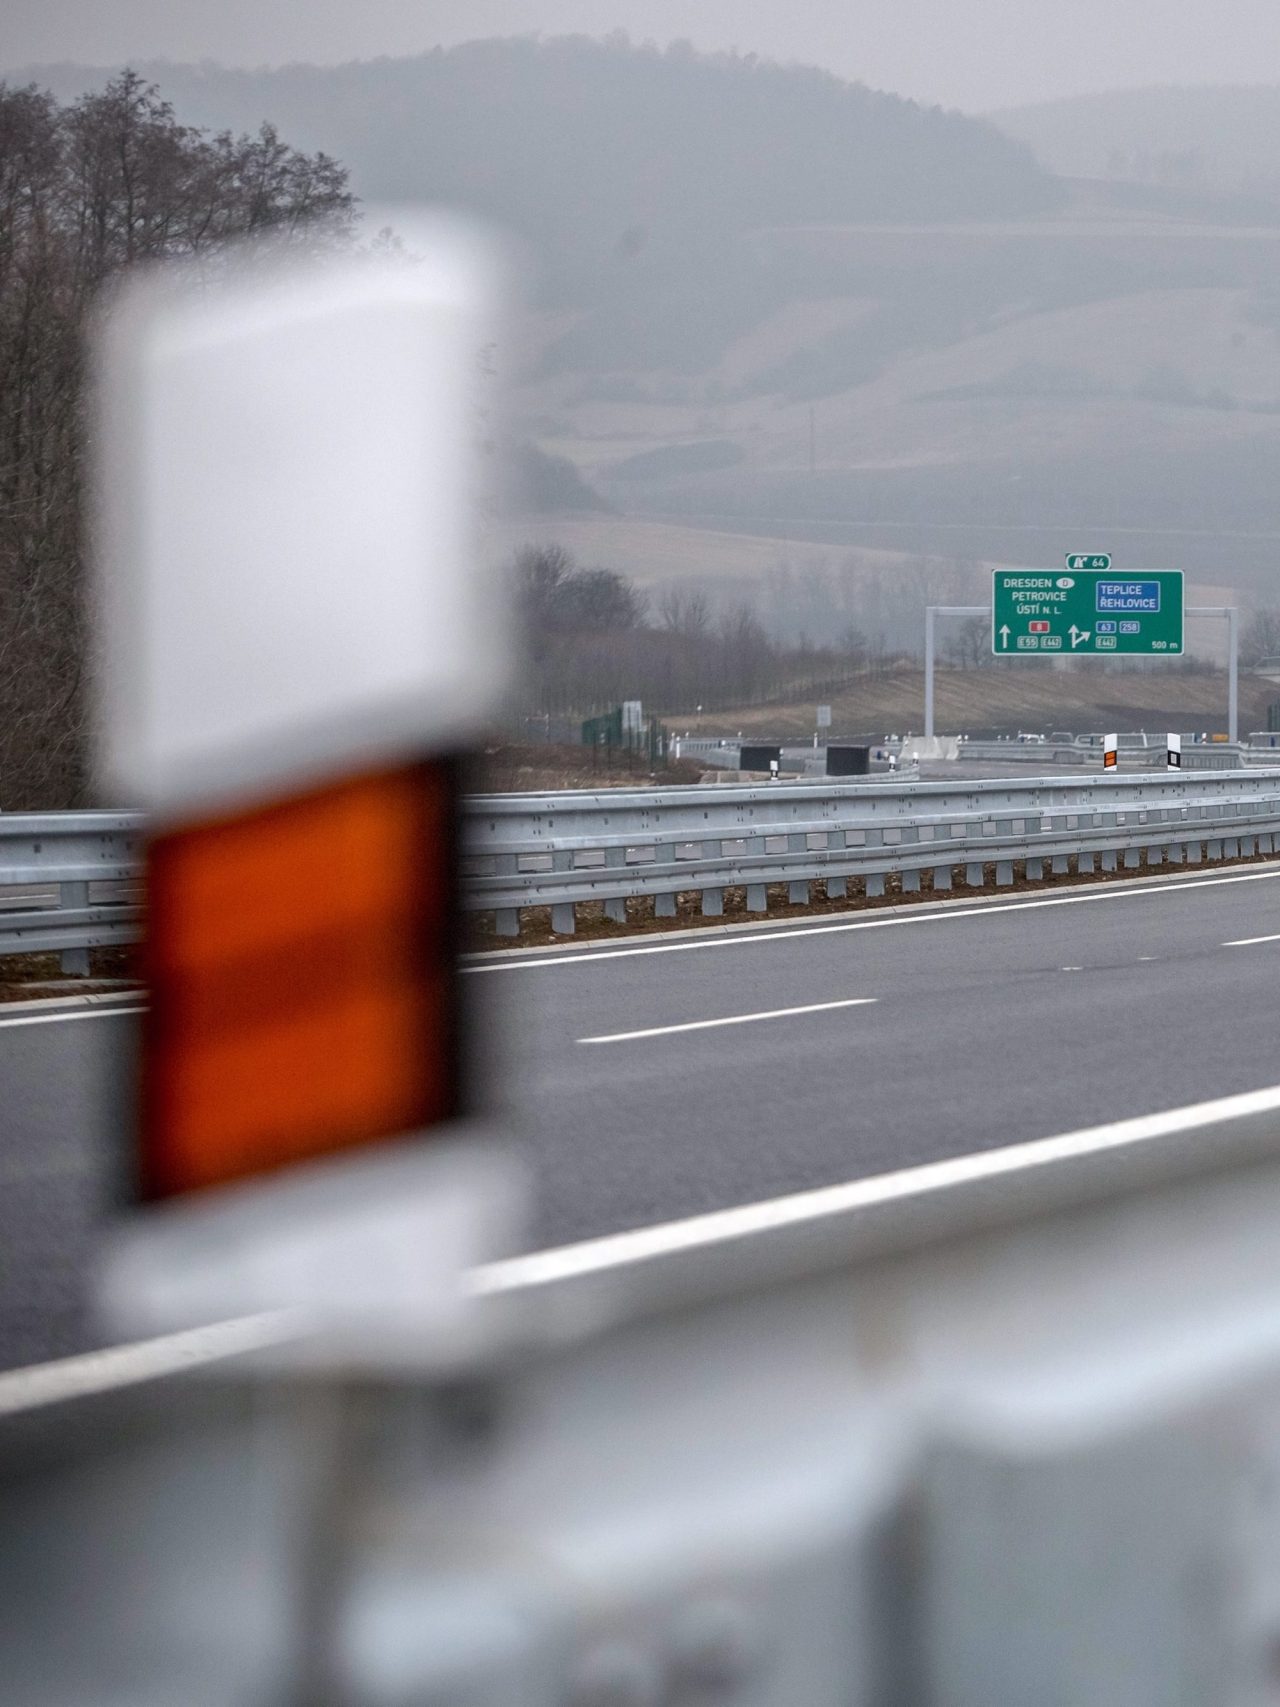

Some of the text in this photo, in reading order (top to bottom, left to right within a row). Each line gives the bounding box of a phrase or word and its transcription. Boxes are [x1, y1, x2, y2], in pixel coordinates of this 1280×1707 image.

[1092, 558, 1104, 567] 64
[1004, 578, 1052, 588] DRESDEN
[1101, 585, 1142, 595] TEPLICE
[1012, 592, 1067, 602] PETROVICE
[1100, 597, 1156, 608] ŘEHLOVICE
[1017, 602, 1040, 614] ÚSTÍ
